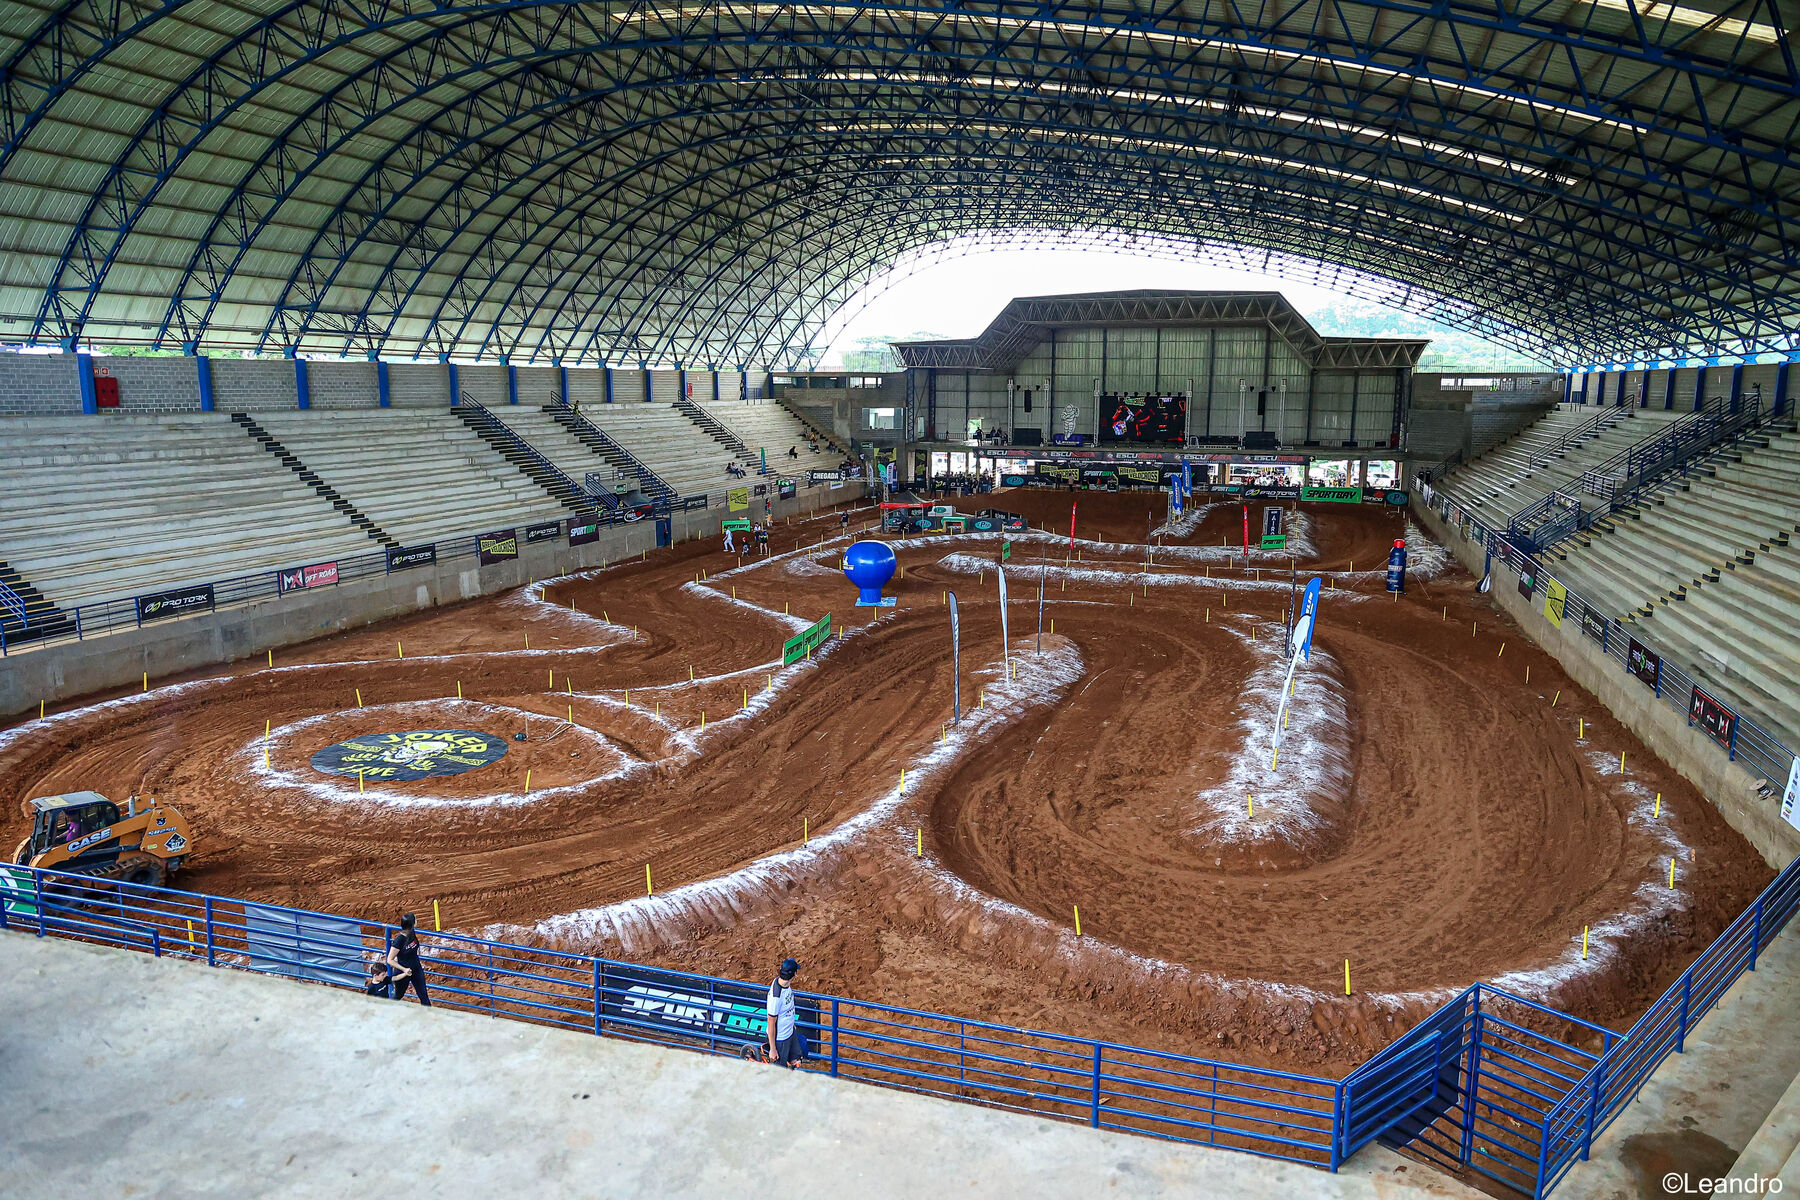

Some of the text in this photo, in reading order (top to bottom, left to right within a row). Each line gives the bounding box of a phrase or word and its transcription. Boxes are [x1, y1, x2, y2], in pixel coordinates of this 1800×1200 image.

[812, 472, 839, 480] CHEGADA
[1306, 489, 1357, 499] SPORTBAY
[305, 573, 317, 584] OFF
[318, 567, 337, 579] ROAD
[161, 594, 208, 608] PRO TORK
[379, 732, 488, 754] JOKER
[338, 763, 399, 777] LINE
[67, 827, 112, 852] CASE
[621, 985, 799, 1037] SPORTBA
